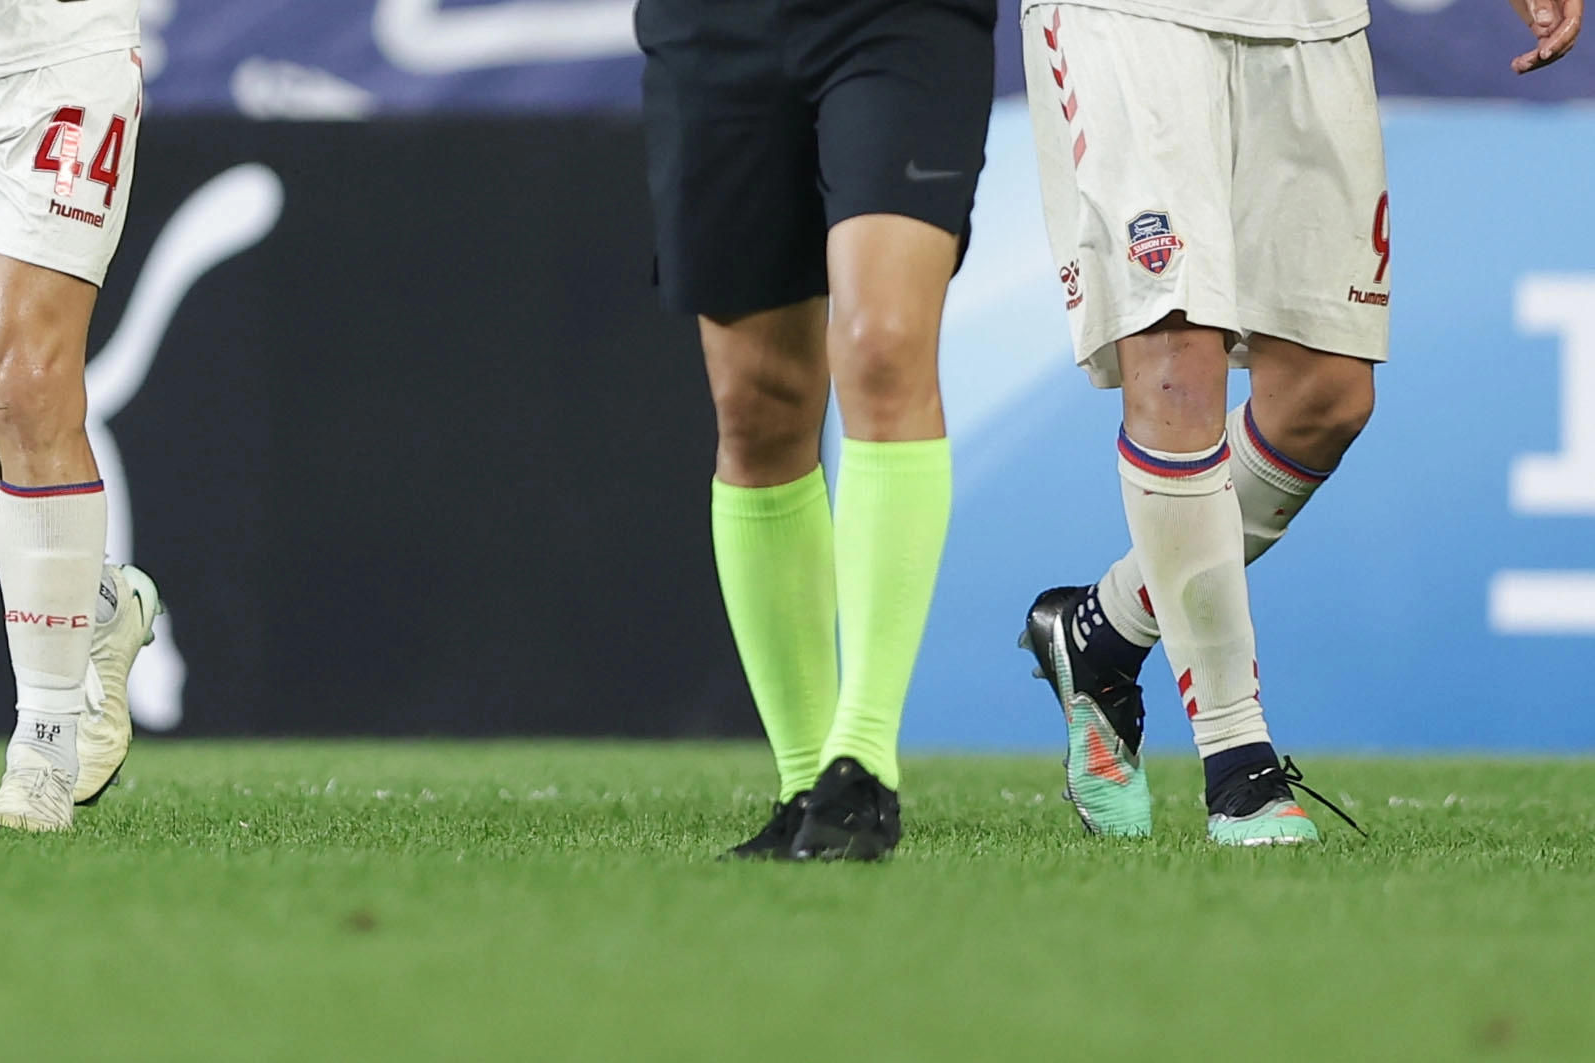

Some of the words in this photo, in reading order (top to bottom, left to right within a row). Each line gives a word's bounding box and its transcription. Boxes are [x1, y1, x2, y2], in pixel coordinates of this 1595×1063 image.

[31, 104, 127, 210] 44
[48, 198, 106, 229] hummel
[1372, 191, 1390, 284] 9
[1348, 285, 1391, 307] hummel
